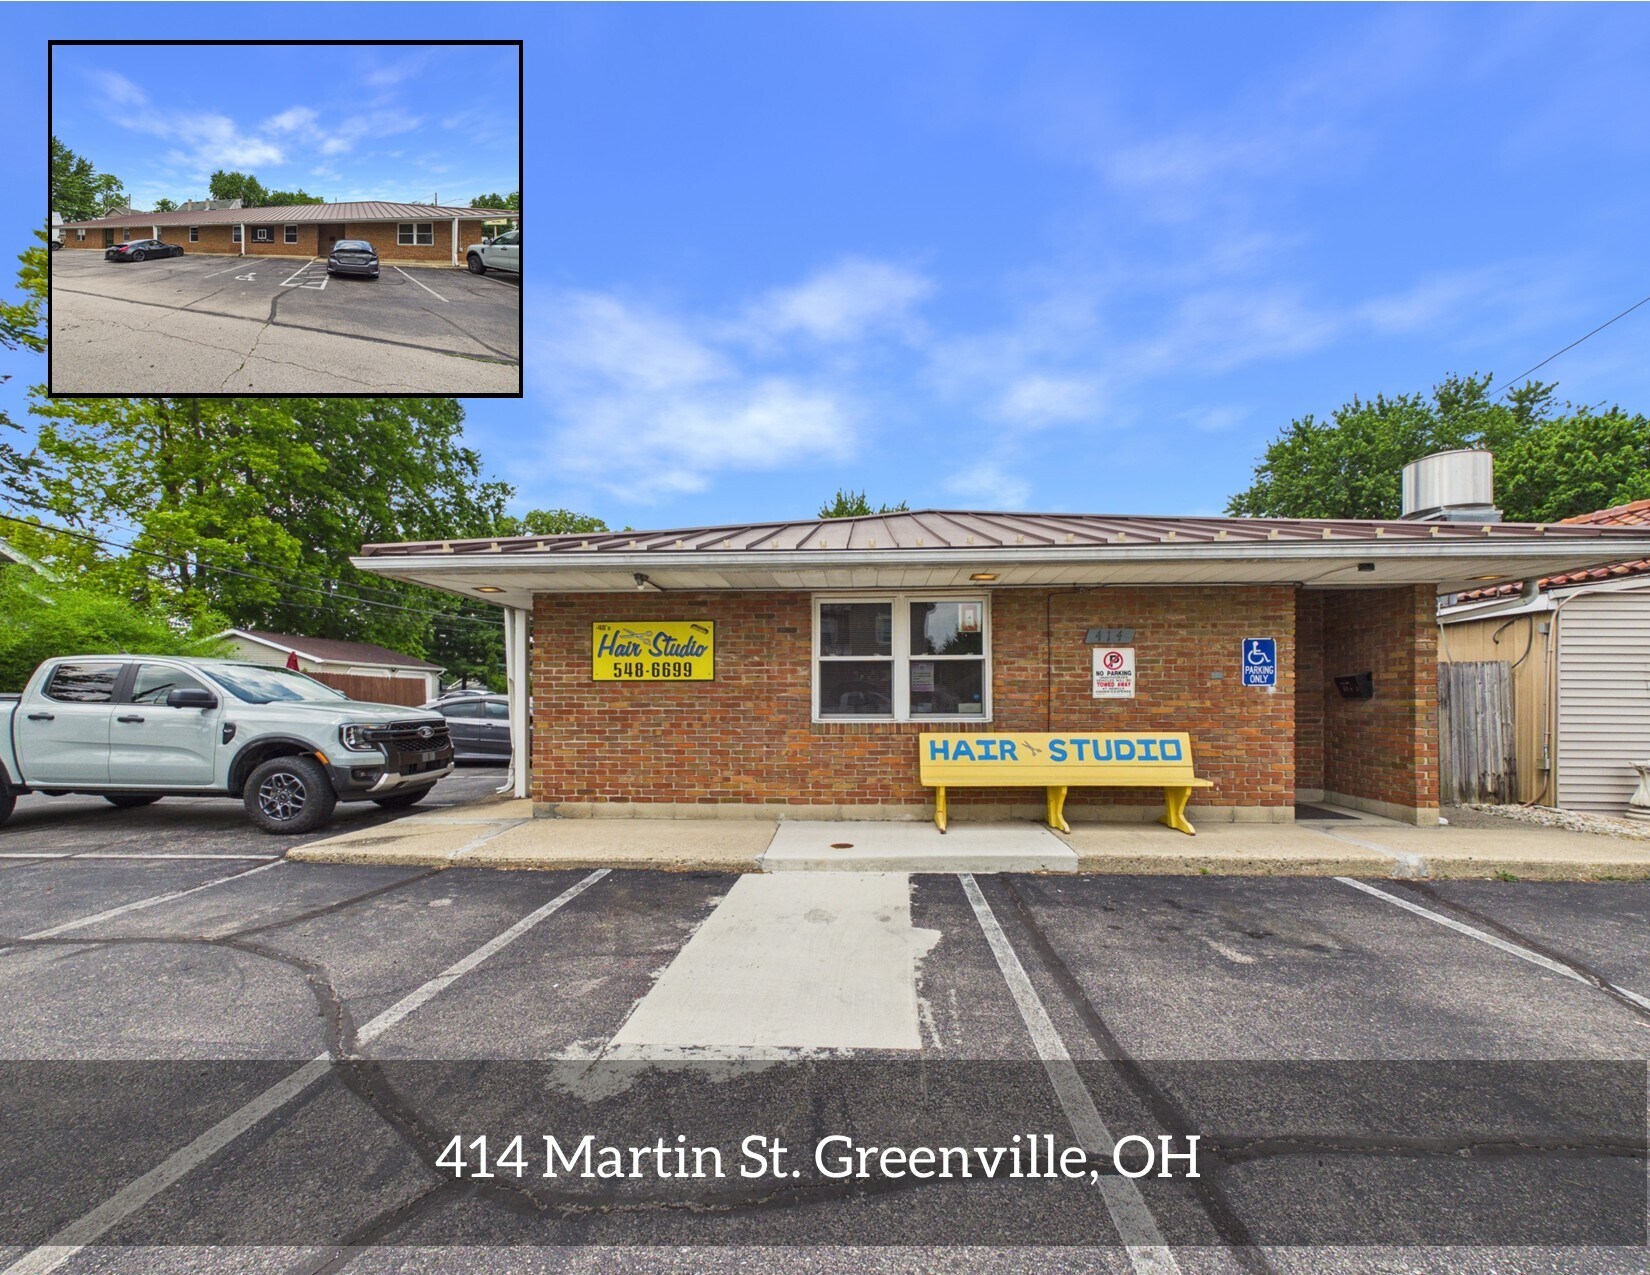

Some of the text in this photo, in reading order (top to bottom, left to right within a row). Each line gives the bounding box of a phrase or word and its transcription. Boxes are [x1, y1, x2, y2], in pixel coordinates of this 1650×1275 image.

[1095, 630, 1123, 642] 414
[597, 630, 708, 658] Hair Studio
[613, 662, 692, 678] 548-6699
[1245, 665, 1274, 675] PARKING
[1250, 674, 1269, 683] ONLY
[929, 739, 1183, 762] HAIR STUDIO
